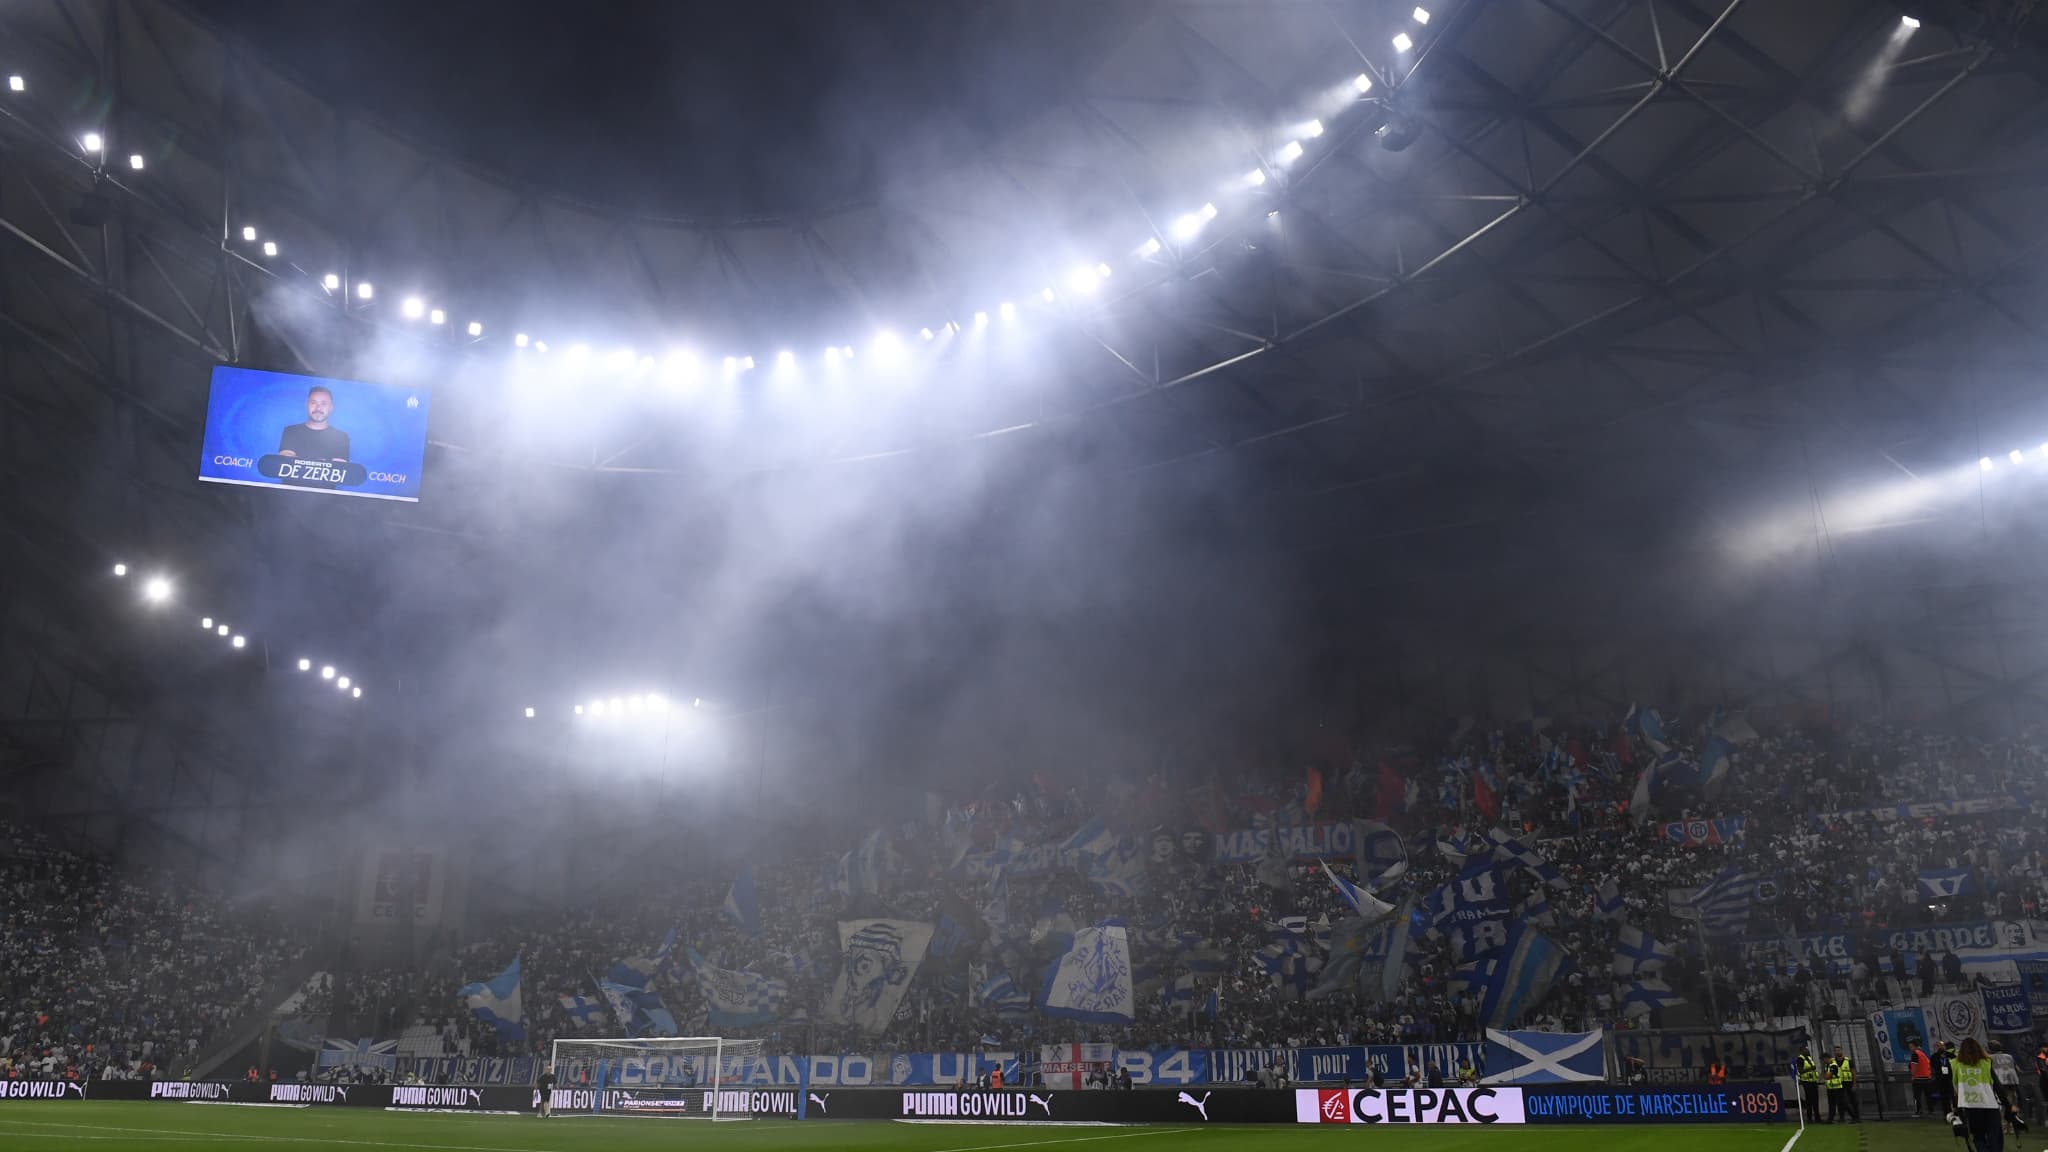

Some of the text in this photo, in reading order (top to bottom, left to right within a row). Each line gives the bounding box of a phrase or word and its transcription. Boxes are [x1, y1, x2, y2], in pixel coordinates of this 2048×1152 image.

[213, 455, 253, 468] COACH
[294, 459, 332, 468] ROBERTO
[278, 464, 347, 484] DE ZERBI
[369, 472, 406, 484] COACH
[1889, 924, 1992, 952] GARDE
[619, 1054, 873, 1085] COMMANDO
[1116, 1052, 1195, 1086] 84
[1312, 1052, 1350, 1080] pour
[270, 1083, 300, 1101] PUMA
[392, 1086, 426, 1104] PUMA
[532, 1088, 571, 1109] PMA
[903, 1092, 957, 1115] PUMA
[1353, 1087, 1499, 1124] CEPAC
[1528, 1092, 1778, 1119] OLYMPIQUE DE MARSEILLE 1899
